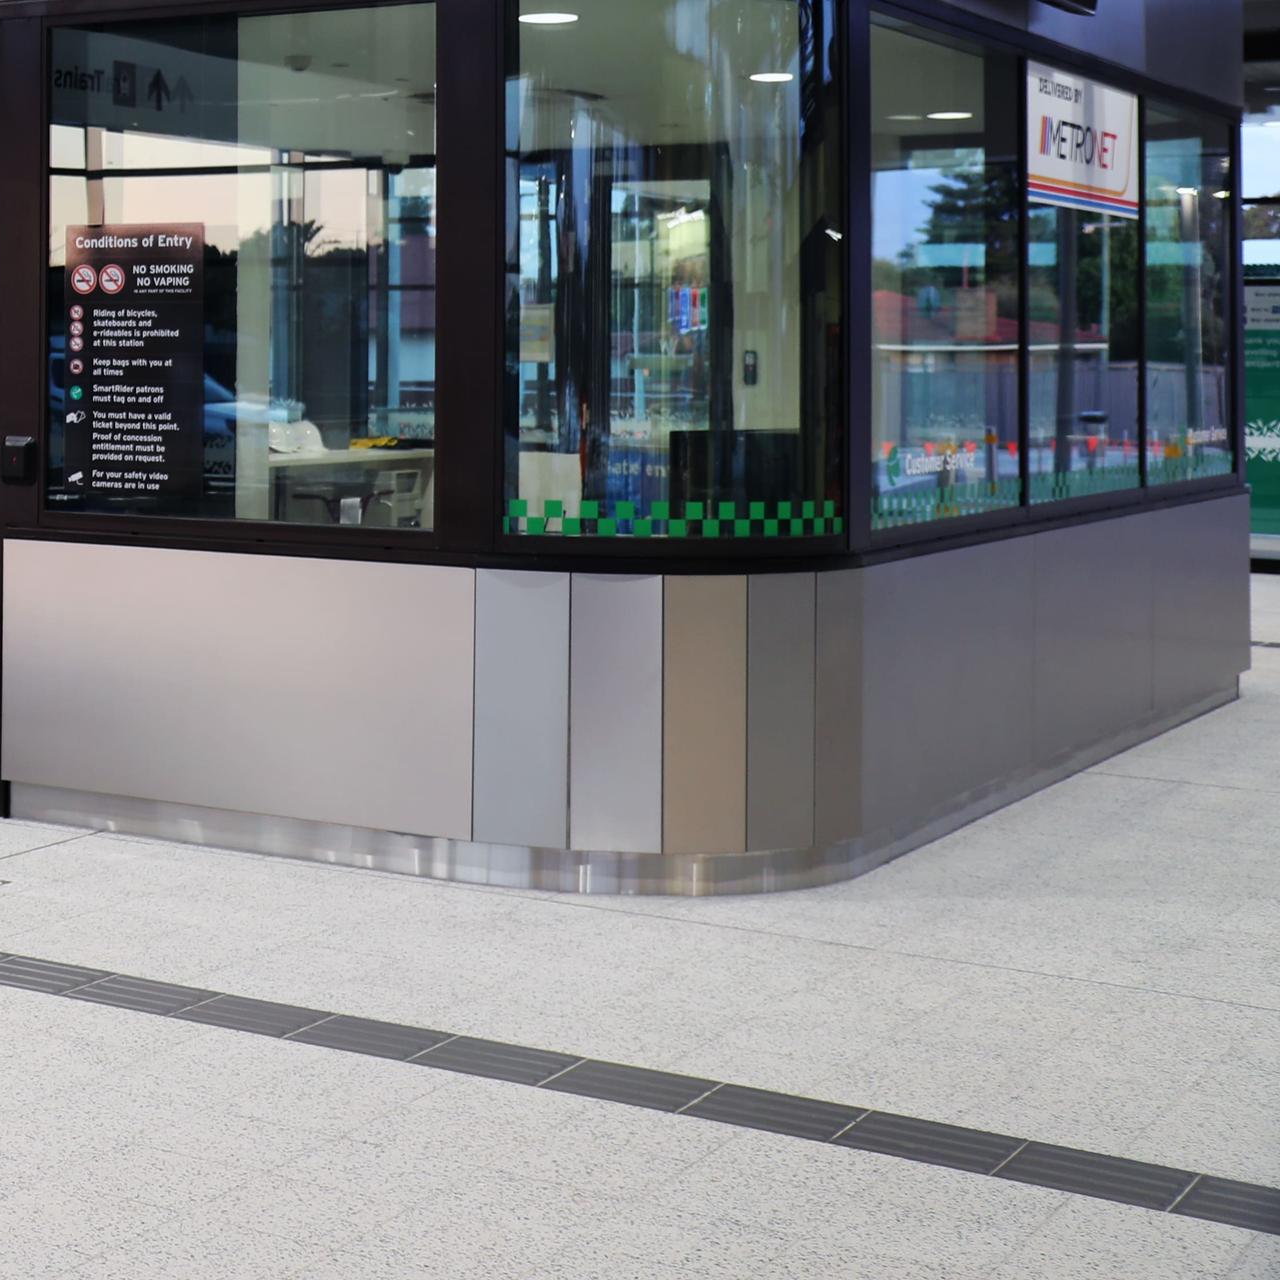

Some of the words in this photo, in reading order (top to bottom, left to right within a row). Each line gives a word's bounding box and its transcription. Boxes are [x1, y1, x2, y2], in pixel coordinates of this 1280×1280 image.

[1038, 77, 1072, 102] DELIVERED
[1073, 88, 1083, 104] BY
[1049, 118, 1118, 170] METRONET
[75, 235, 138, 249] Conditions
[141, 234, 154, 248] of
[158, 234, 193, 249] Entry
[132, 265, 147, 274] NO
[149, 264, 194, 274] SMOKING
[136, 277, 151, 287] NO
[153, 277, 190, 286] VAPING
[93, 309, 116, 318] Riding
[118, 309, 124, 317] of
[126, 309, 158, 318] bicycles,
[93, 329, 132, 337] e-rideables
[142, 329, 179, 338] prohibited
[93, 358, 110, 366] Keep
[112, 358, 129, 367] bags
[149, 360, 162, 368] you
[92, 384, 134, 392] SmartRider
[136, 386, 164, 394] patrons
[113, 395, 124, 404] tag
[115, 422, 140, 430] beyond
[158, 423, 180, 432] point.
[123, 434, 162, 442] concession
[92, 443, 134, 451] entitlement
[156, 444, 166, 452] be
[92, 453, 122, 461] provided
[135, 454, 165, 463] request.
[92, 470, 104, 478] For
[106, 470, 122, 480] your
[124, 471, 147, 480] safety
[149, 472, 168, 480] video
[92, 481, 122, 489] cameras
